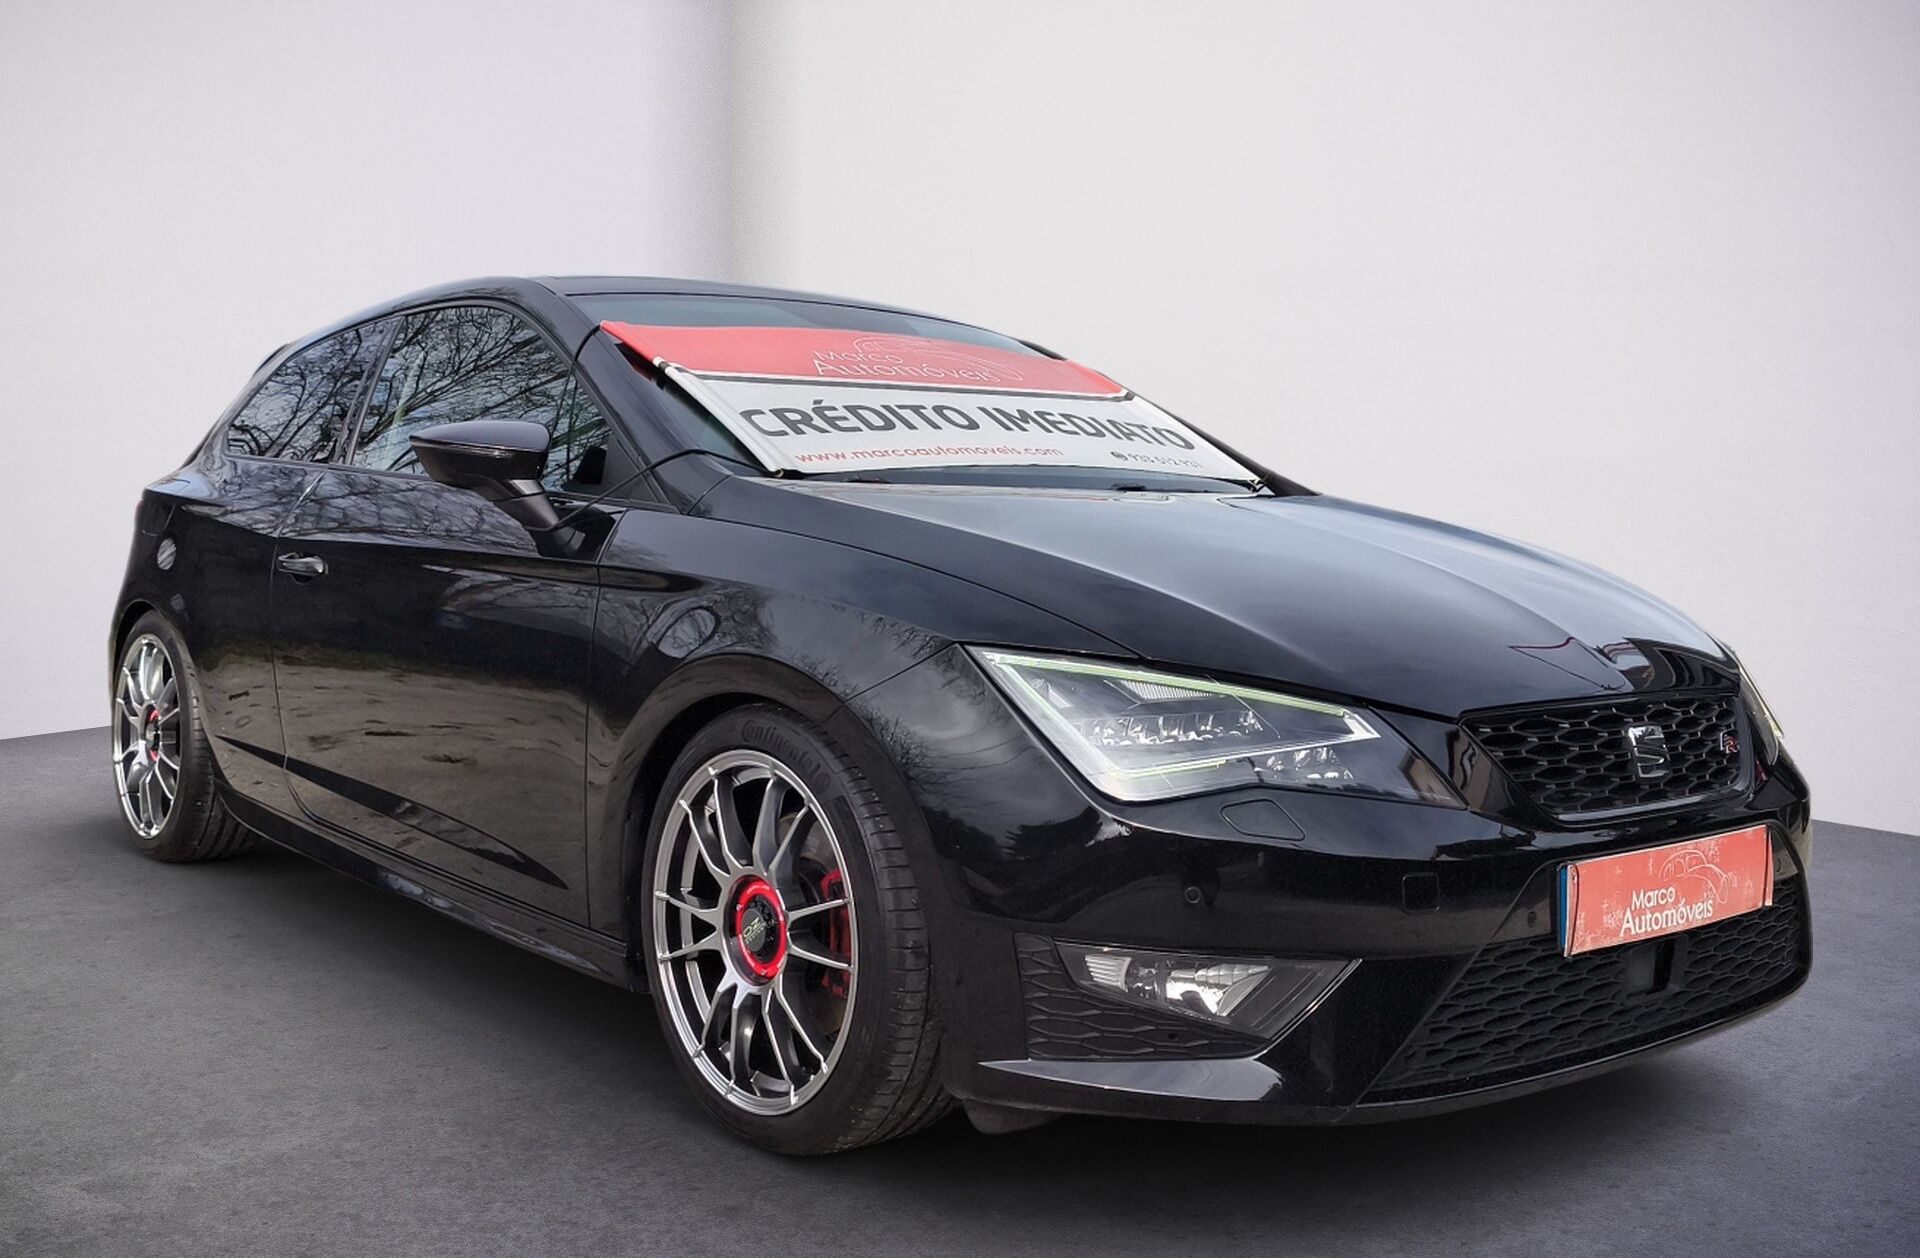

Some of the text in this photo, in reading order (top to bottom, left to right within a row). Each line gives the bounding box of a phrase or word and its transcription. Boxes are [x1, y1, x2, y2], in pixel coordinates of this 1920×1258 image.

[813, 350, 903, 364] Marco
[739, 399, 1196, 450] CRÉDITO IMEDIATO
[795, 445, 1064, 462] www.marcoautomoveis.com
[1631, 886, 1676, 911] Marco
[1619, 898, 1713, 937] Automóveis
